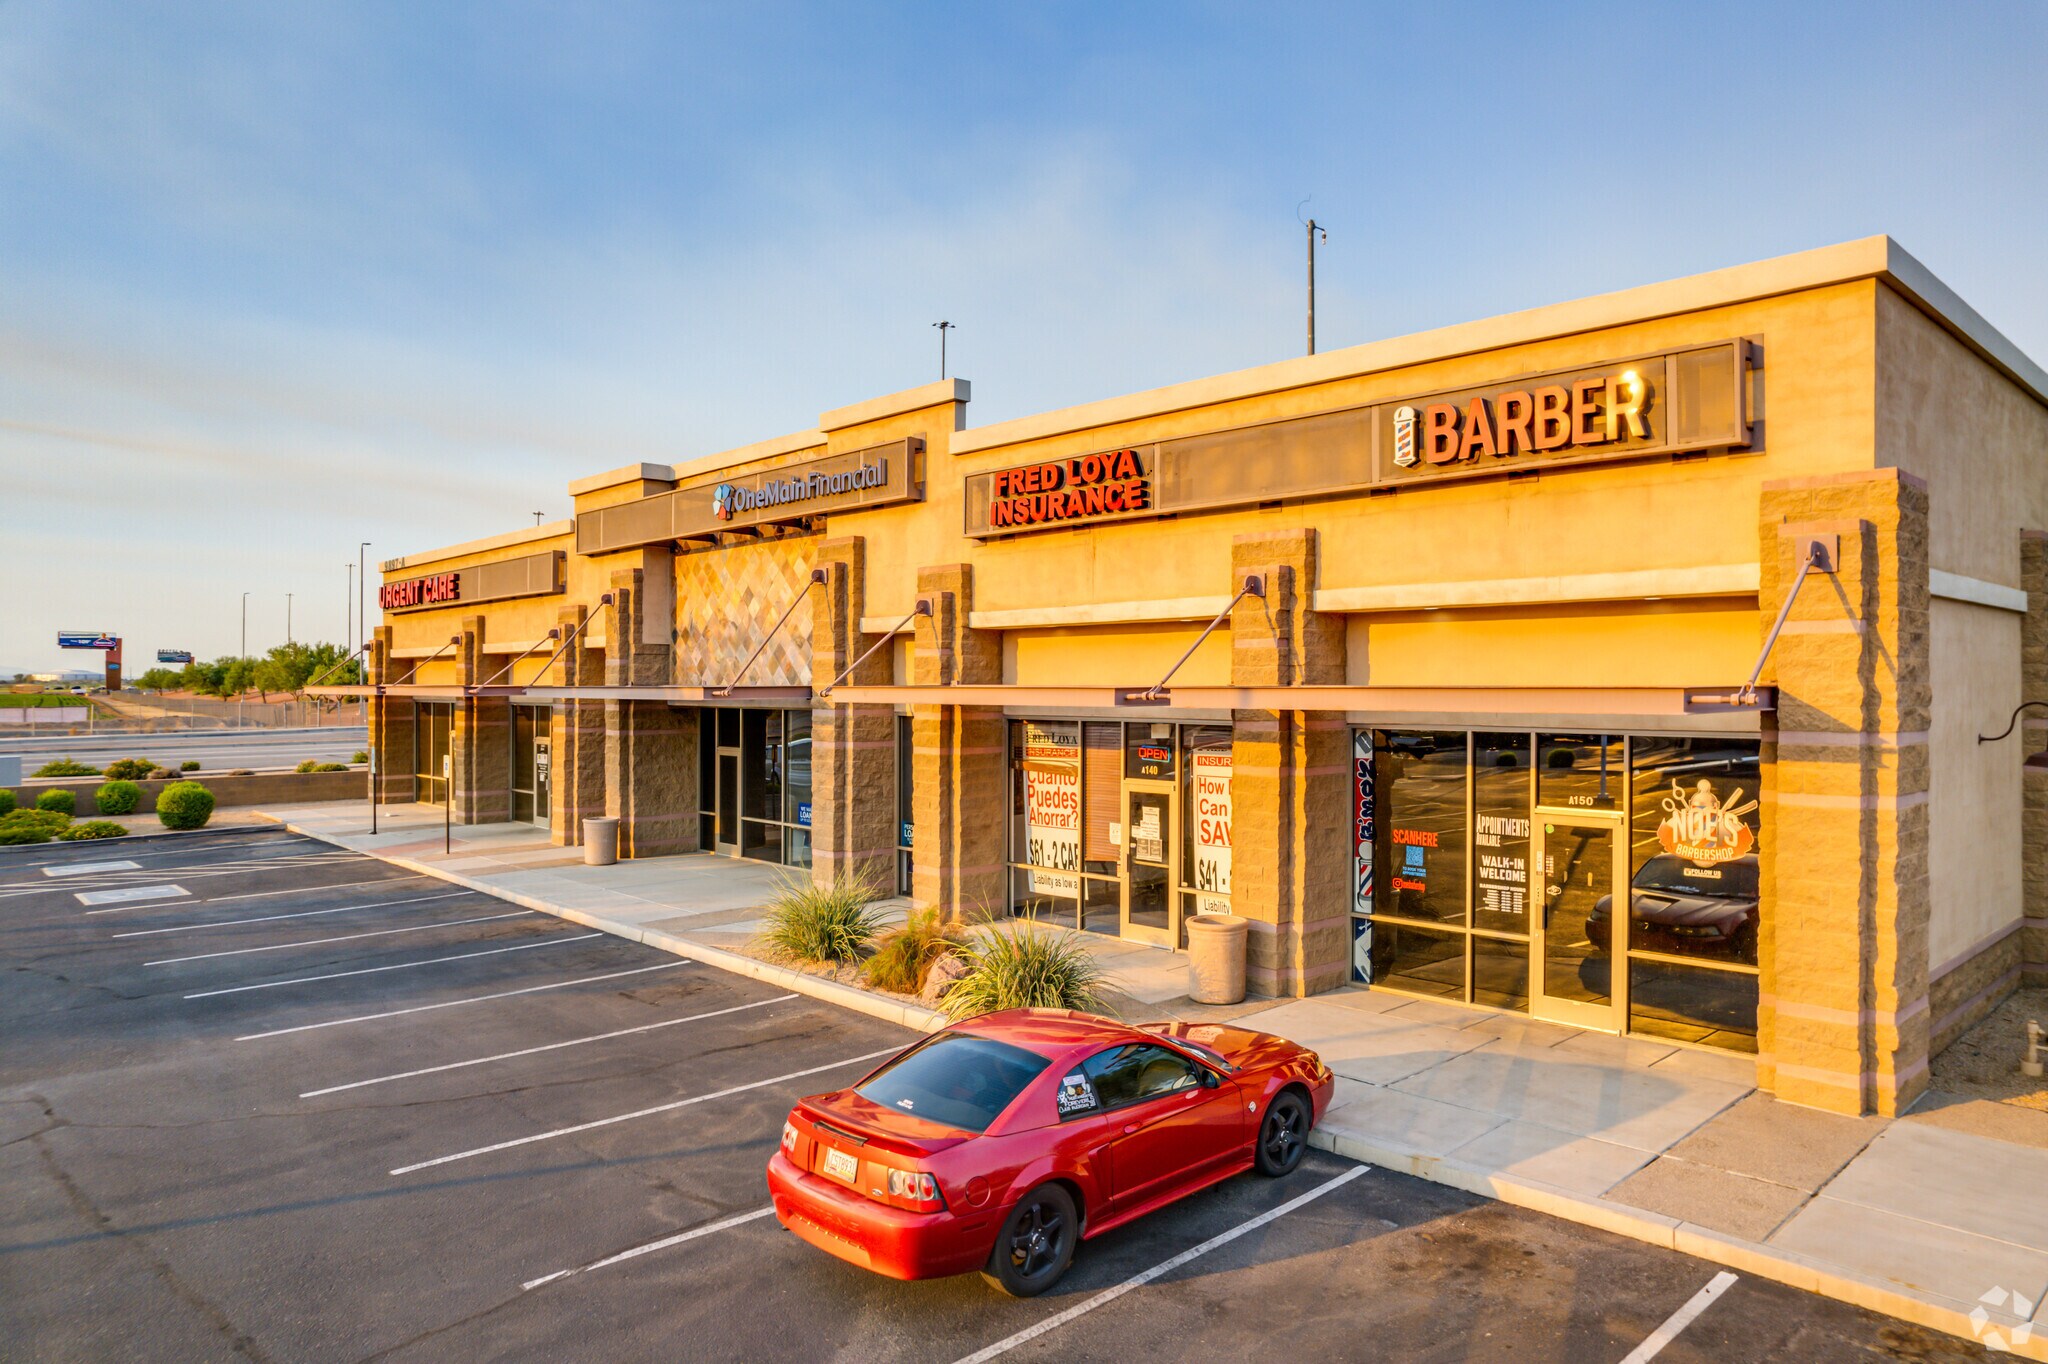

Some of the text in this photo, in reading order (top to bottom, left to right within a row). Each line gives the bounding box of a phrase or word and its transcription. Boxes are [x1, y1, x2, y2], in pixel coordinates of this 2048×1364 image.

[1426, 371, 1648, 464] BARBER
[995, 450, 1140, 498] FRED LOYA
[990, 480, 1145, 527] INSURANCE
[379, 573, 458, 609] URGENT CARE
[1051, 732, 1078, 744] LOYA
[1138, 747, 1168, 760] OPEN
[1141, 764, 1158, 775] A140
[1199, 777, 1225, 795] How
[1027, 785, 1078, 810] Puedes
[1568, 796, 1594, 806] A150
[1199, 798, 1227, 816] Can
[1029, 807, 1078, 828] Ahorrar?
[1476, 813, 1530, 837] APPOINTMENTS
[1476, 832, 1501, 847] AVAILABLE
[1029, 838, 1045, 867] $61
[1676, 844, 1734, 860] BARBERSHOP
[1481, 855, 1525, 870] WALK-IN
[1034, 874, 1053, 888] Liability
[1055, 878, 1062, 887] as
[1063, 877, 1073, 889] low
[1199, 857, 1218, 892] $41
[1479, 867, 1526, 882] WELCOME
[1204, 898, 1230, 914] Liability
